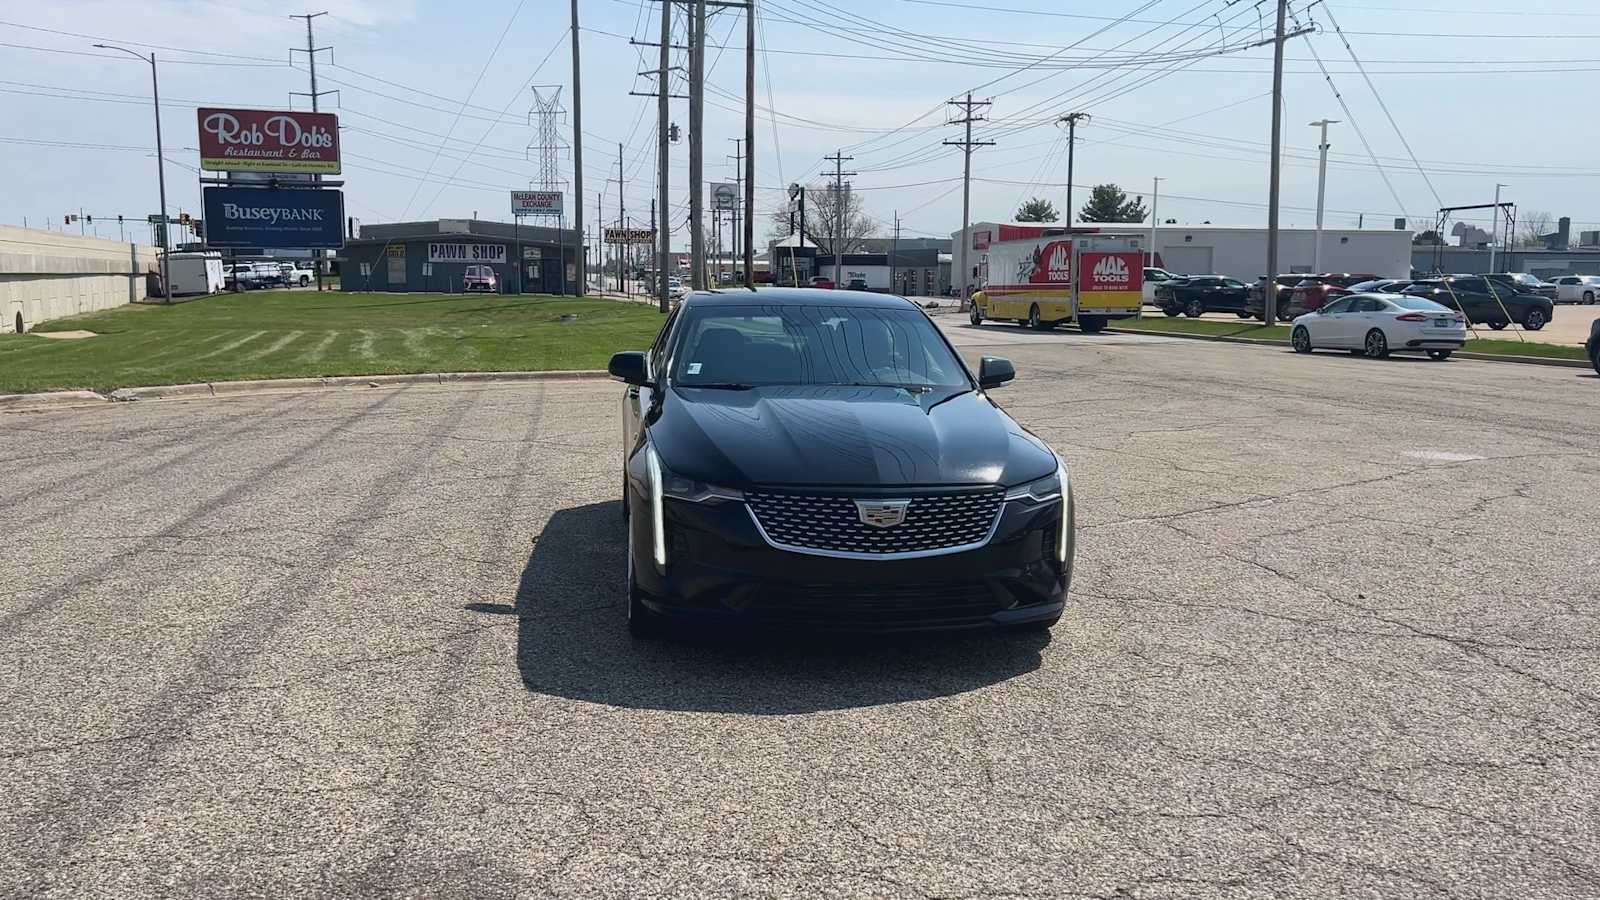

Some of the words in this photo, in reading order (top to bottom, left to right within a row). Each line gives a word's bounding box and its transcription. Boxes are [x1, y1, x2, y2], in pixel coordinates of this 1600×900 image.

[204, 112, 264, 145] Rob
[264, 115, 333, 148] Dob's
[225, 147, 284, 158] Restaurant
[289, 148, 297, 158] &
[301, 149, 321, 159] Bar
[537, 193, 561, 201] COUNTY
[521, 200, 553, 208] EXCHANGE
[605, 229, 628, 239] PAWN
[630, 230, 651, 239] SHOP
[430, 244, 466, 259] PAWN
[472, 244, 504, 260] SHOP
[1048, 245, 1070, 271] MAC
[1093, 255, 1129, 275] MAC
[1048, 271, 1069, 281] TOOLS
